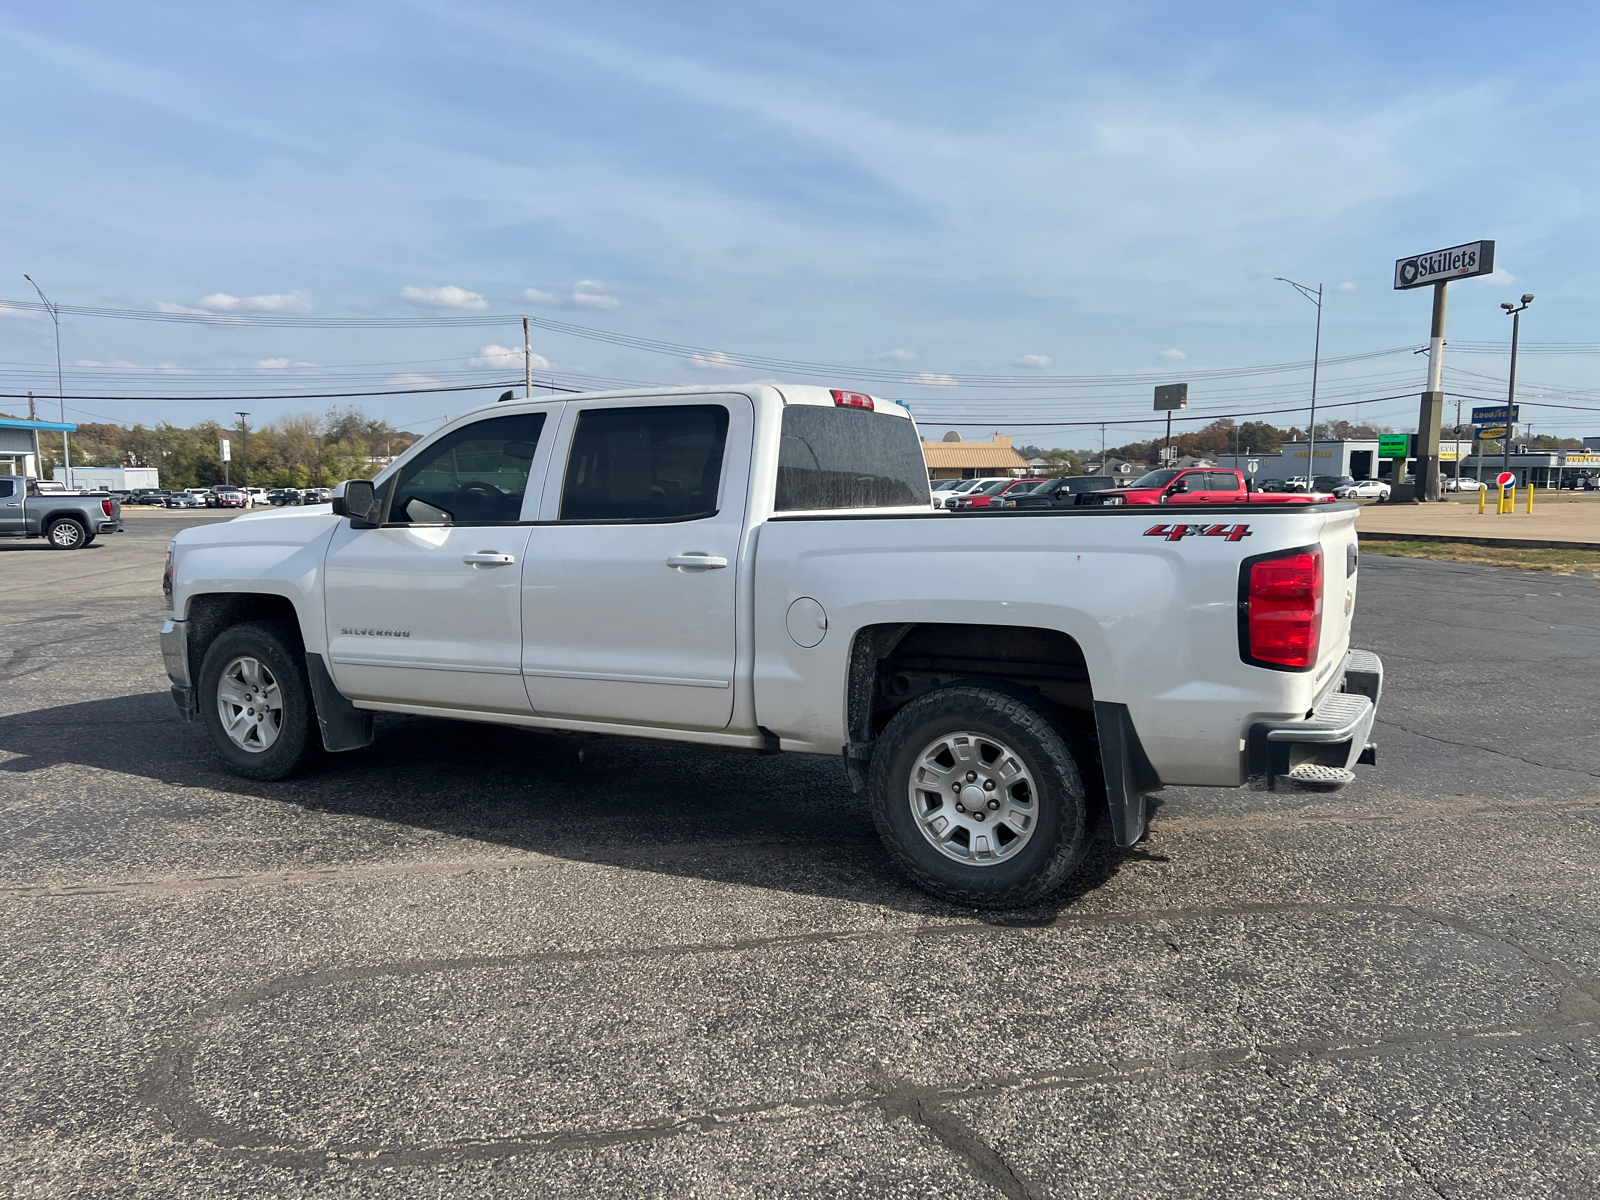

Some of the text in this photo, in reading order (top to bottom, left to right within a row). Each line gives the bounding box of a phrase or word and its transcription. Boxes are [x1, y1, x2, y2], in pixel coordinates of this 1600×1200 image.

[1419, 251, 1476, 277] Skillets
[1473, 409, 1518, 419] GOODYER
[341, 627, 410, 637] SILVERADO
